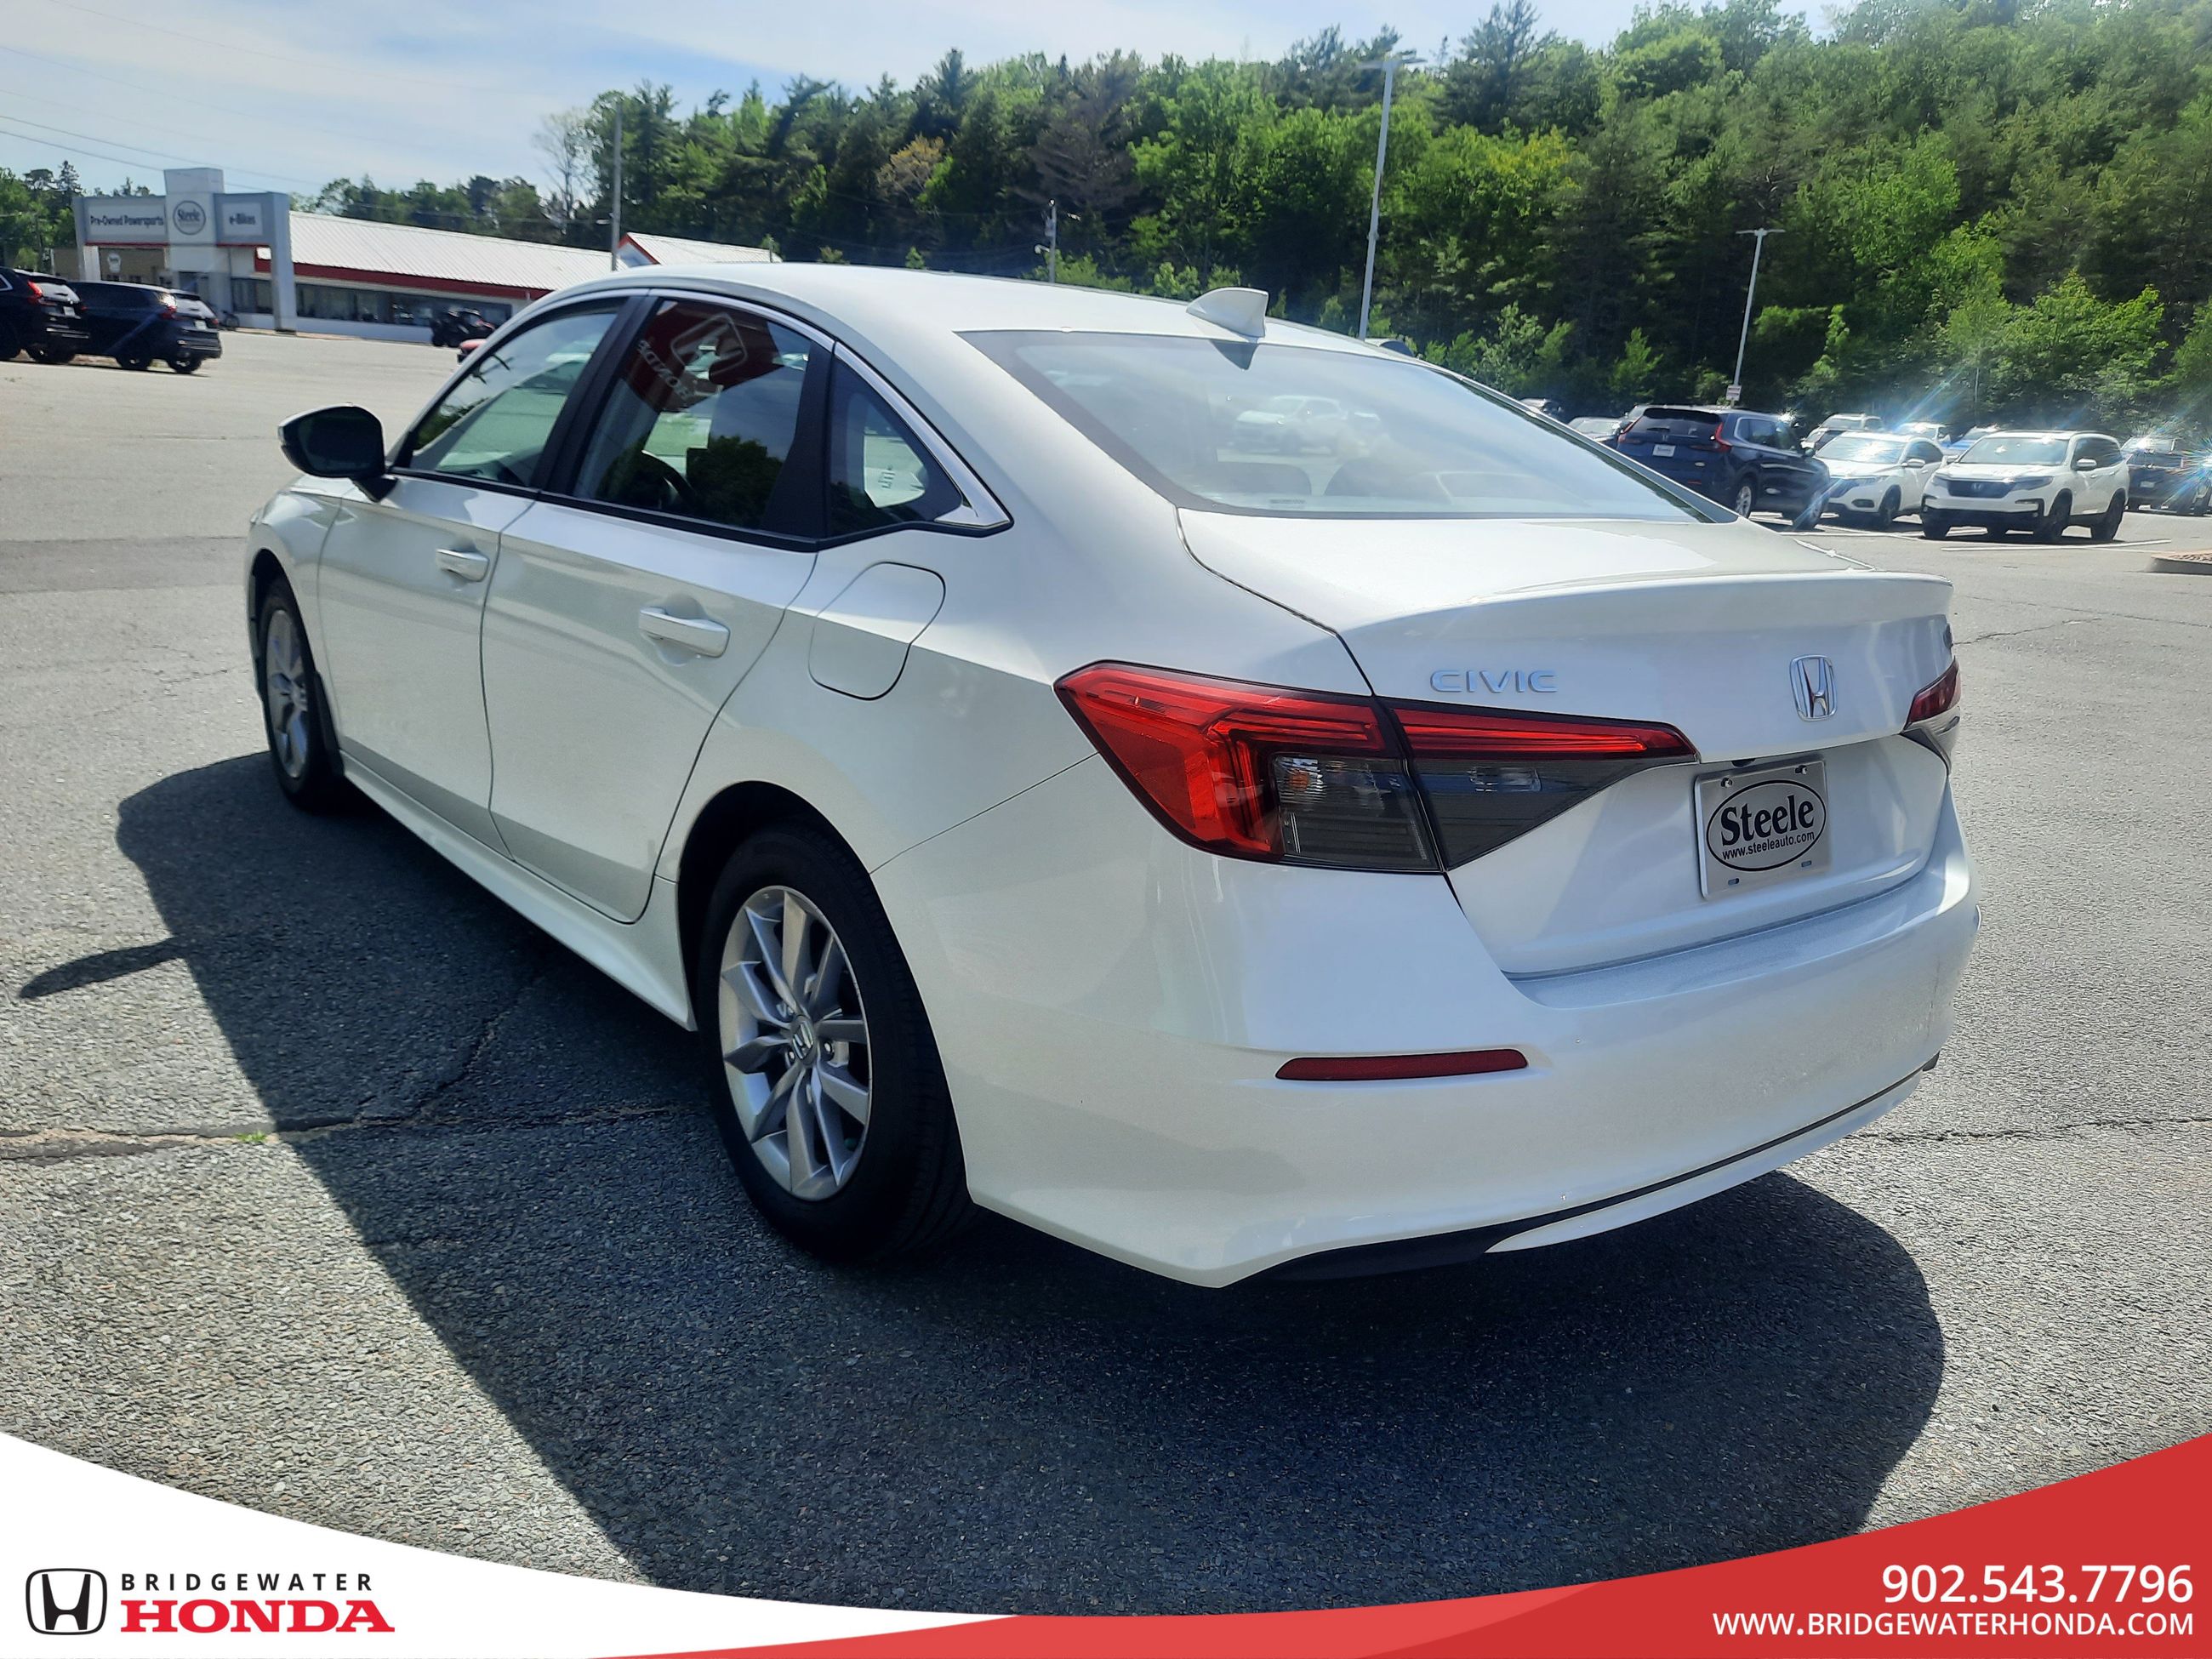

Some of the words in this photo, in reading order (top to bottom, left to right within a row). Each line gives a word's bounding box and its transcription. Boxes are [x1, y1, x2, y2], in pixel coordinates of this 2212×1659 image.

[1430, 670, 1558, 693] CIVIC
[1720, 795, 1815, 847] Steele
[1722, 831, 1815, 860] www.steeleauto.com
